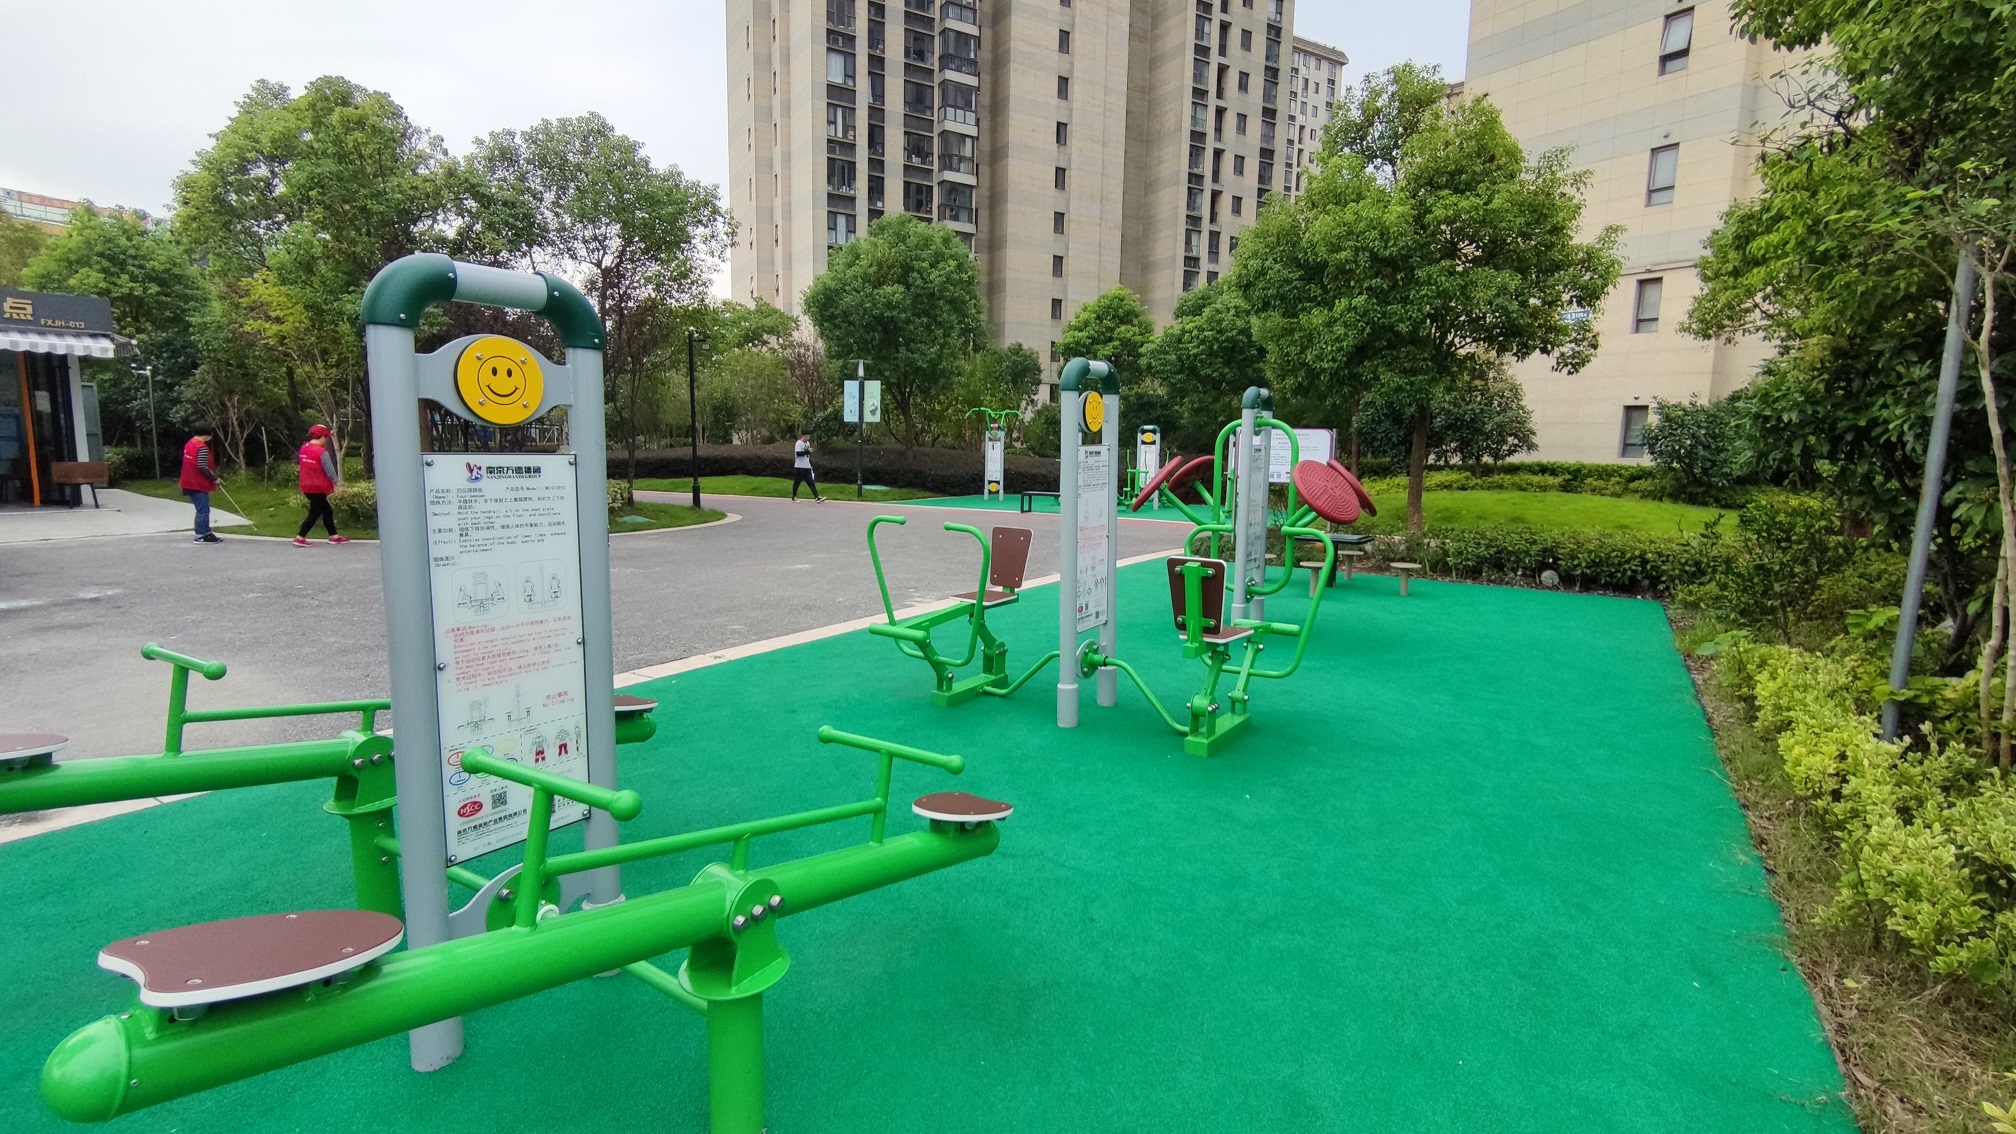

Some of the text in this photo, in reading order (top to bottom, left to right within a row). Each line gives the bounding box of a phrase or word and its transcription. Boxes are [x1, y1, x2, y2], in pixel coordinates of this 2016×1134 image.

[3, 296, 34, 320] 点
[40, 318, 85, 329] FXJH-013
[486, 466, 542, 474] 南京万德集团
